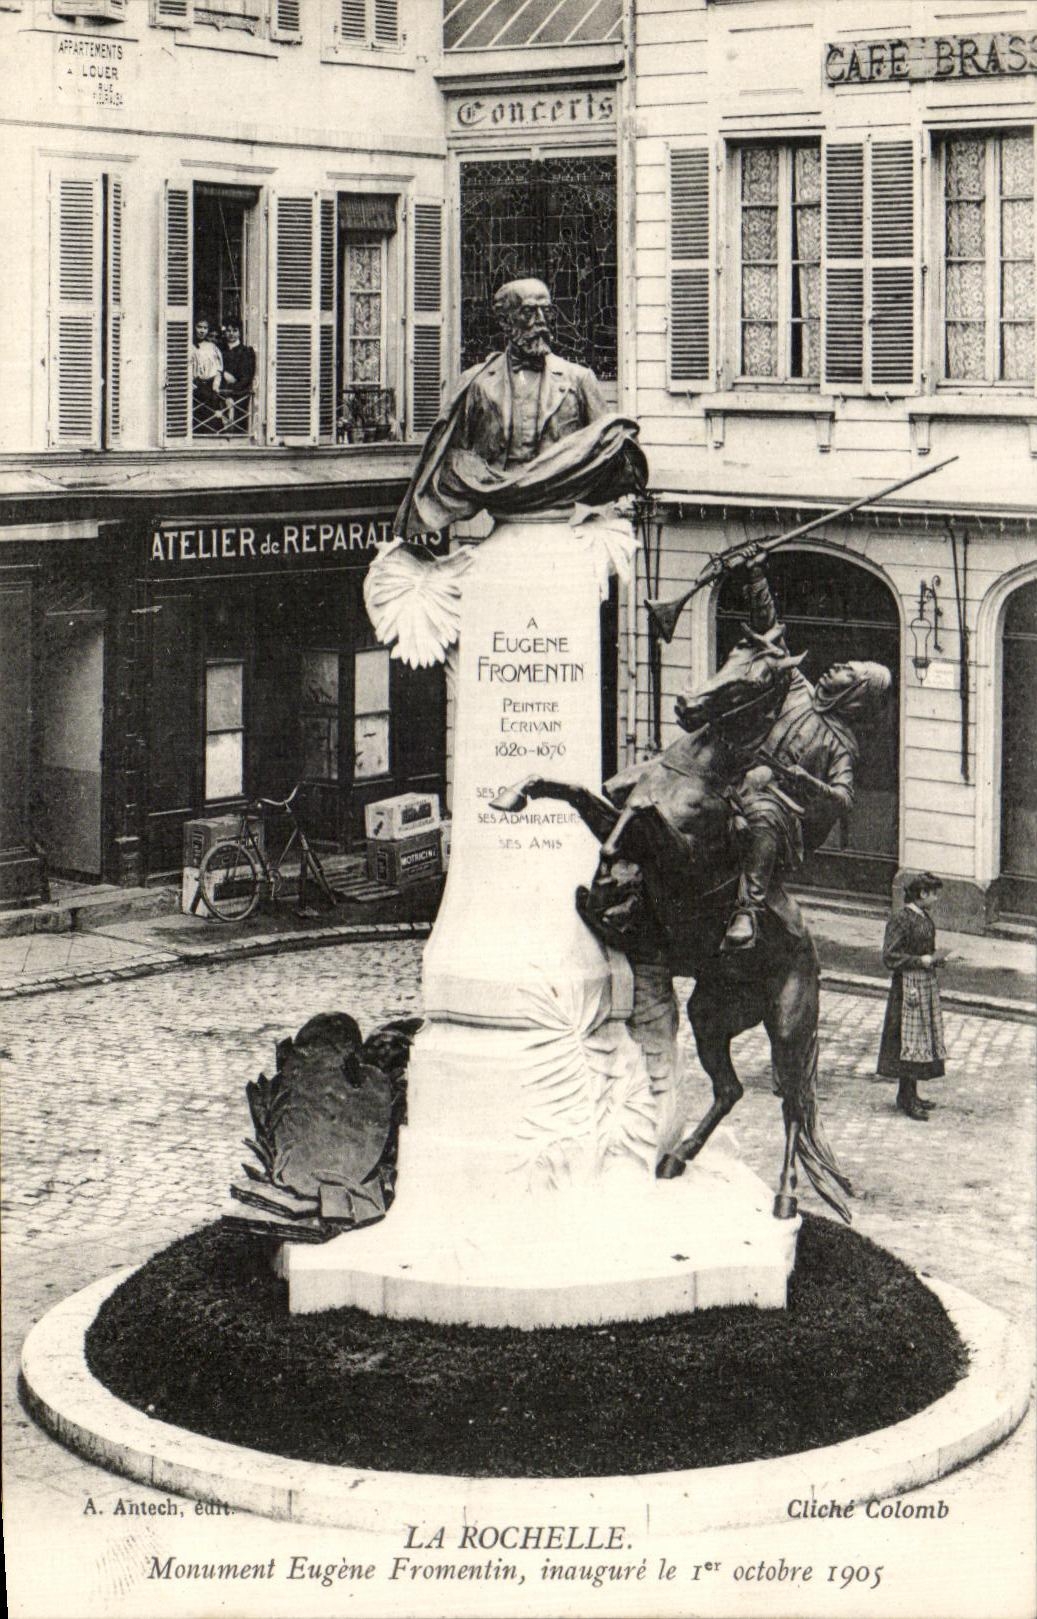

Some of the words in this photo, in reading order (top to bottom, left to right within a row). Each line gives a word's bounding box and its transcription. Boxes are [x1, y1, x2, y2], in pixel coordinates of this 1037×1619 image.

[58, 39, 123, 60] APPARTEMENTS
[82, 63, 119, 80] LOUER
[457, 92, 613, 127] Concerts
[151, 527, 257, 561] ATELIER
[260, 534, 280, 555] de
[526, 616, 539, 630] A
[492, 631, 570, 653] EUGENE
[478, 655, 584, 682] FROMENTIN
[502, 697, 560, 713] PEINTRE
[500, 717, 562, 733] ECRIVAIN
[478, 812, 497, 824] SES
[529, 836, 563, 850] AMIS
